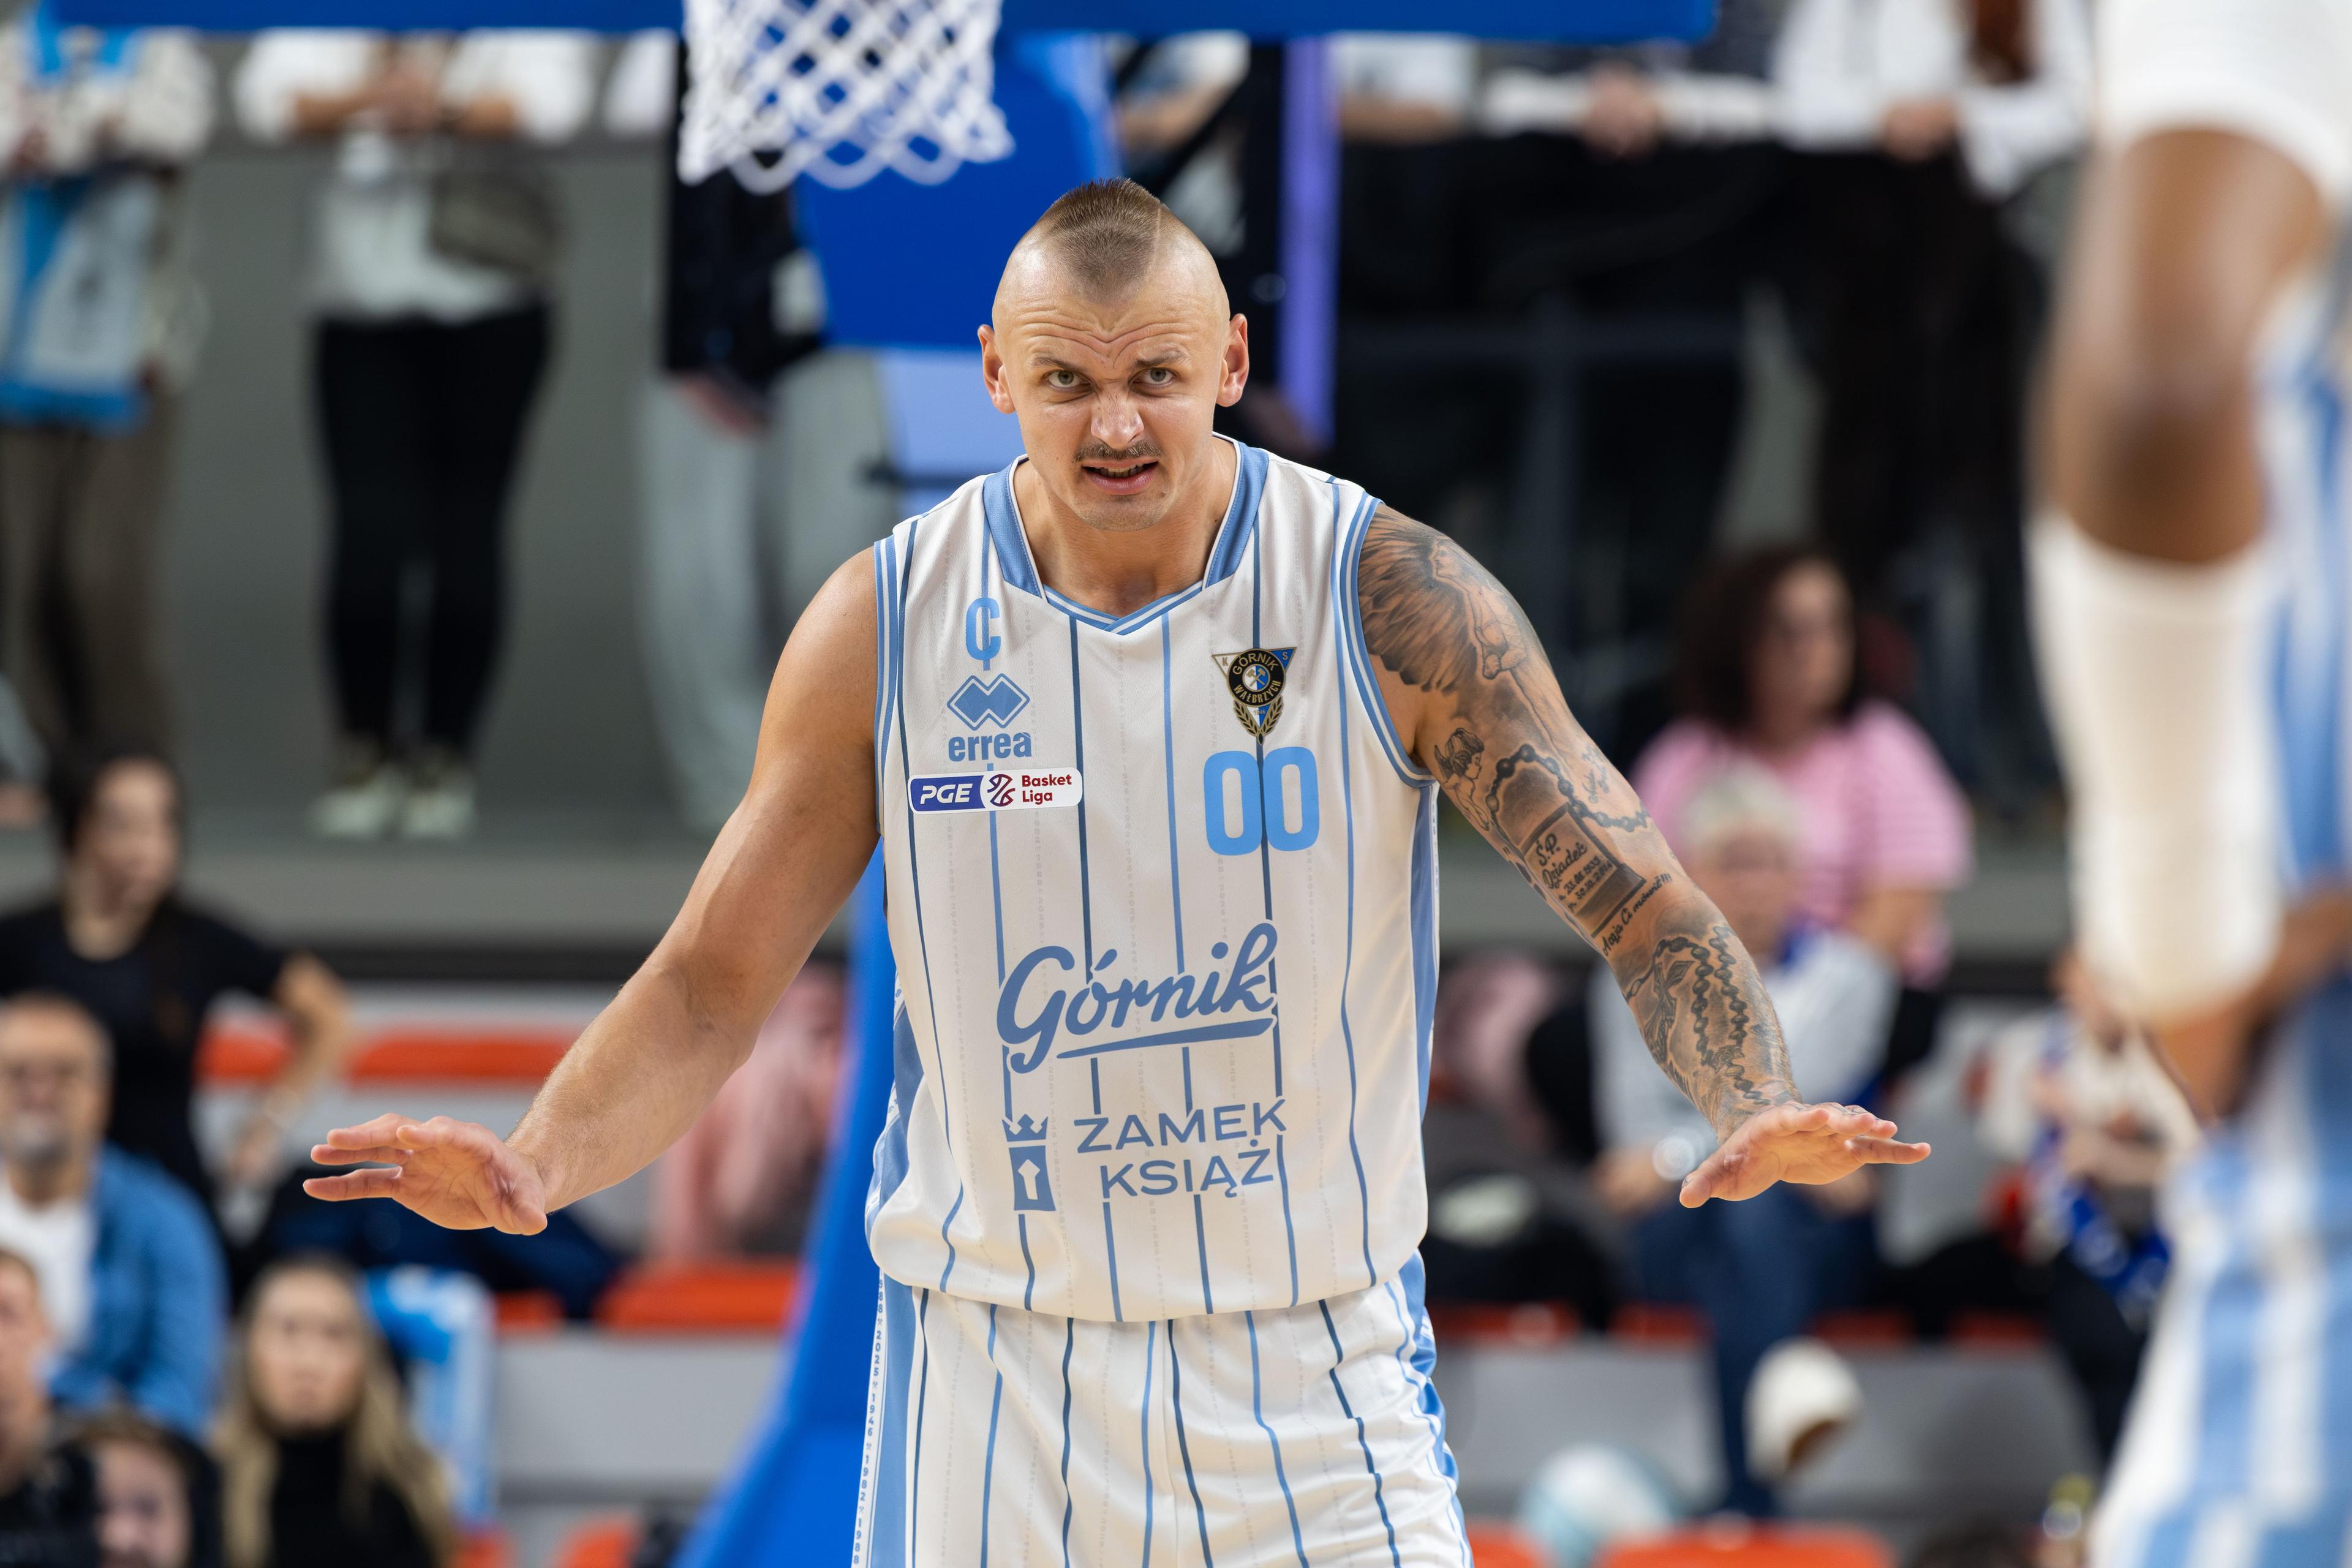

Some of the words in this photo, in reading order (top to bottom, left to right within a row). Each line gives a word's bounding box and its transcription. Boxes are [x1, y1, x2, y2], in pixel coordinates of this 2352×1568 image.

[1232, 653, 1279, 675] GÓRNIK
[1234, 680, 1281, 704] WAŁBRZYCH
[920, 783, 973, 805] PGE
[1022, 774, 1072, 787] Basket
[1022, 790, 1053, 805] Liga
[1204, 746, 1320, 856] 00
[997, 922, 1278, 1074] Górnik
[1074, 1099, 1286, 1153] ZAMEK
[1101, 1139, 1274, 1198] KSIĄŻ
[860, 1455, 869, 1501] 1982
[853, 1518, 862, 1564] 1988
